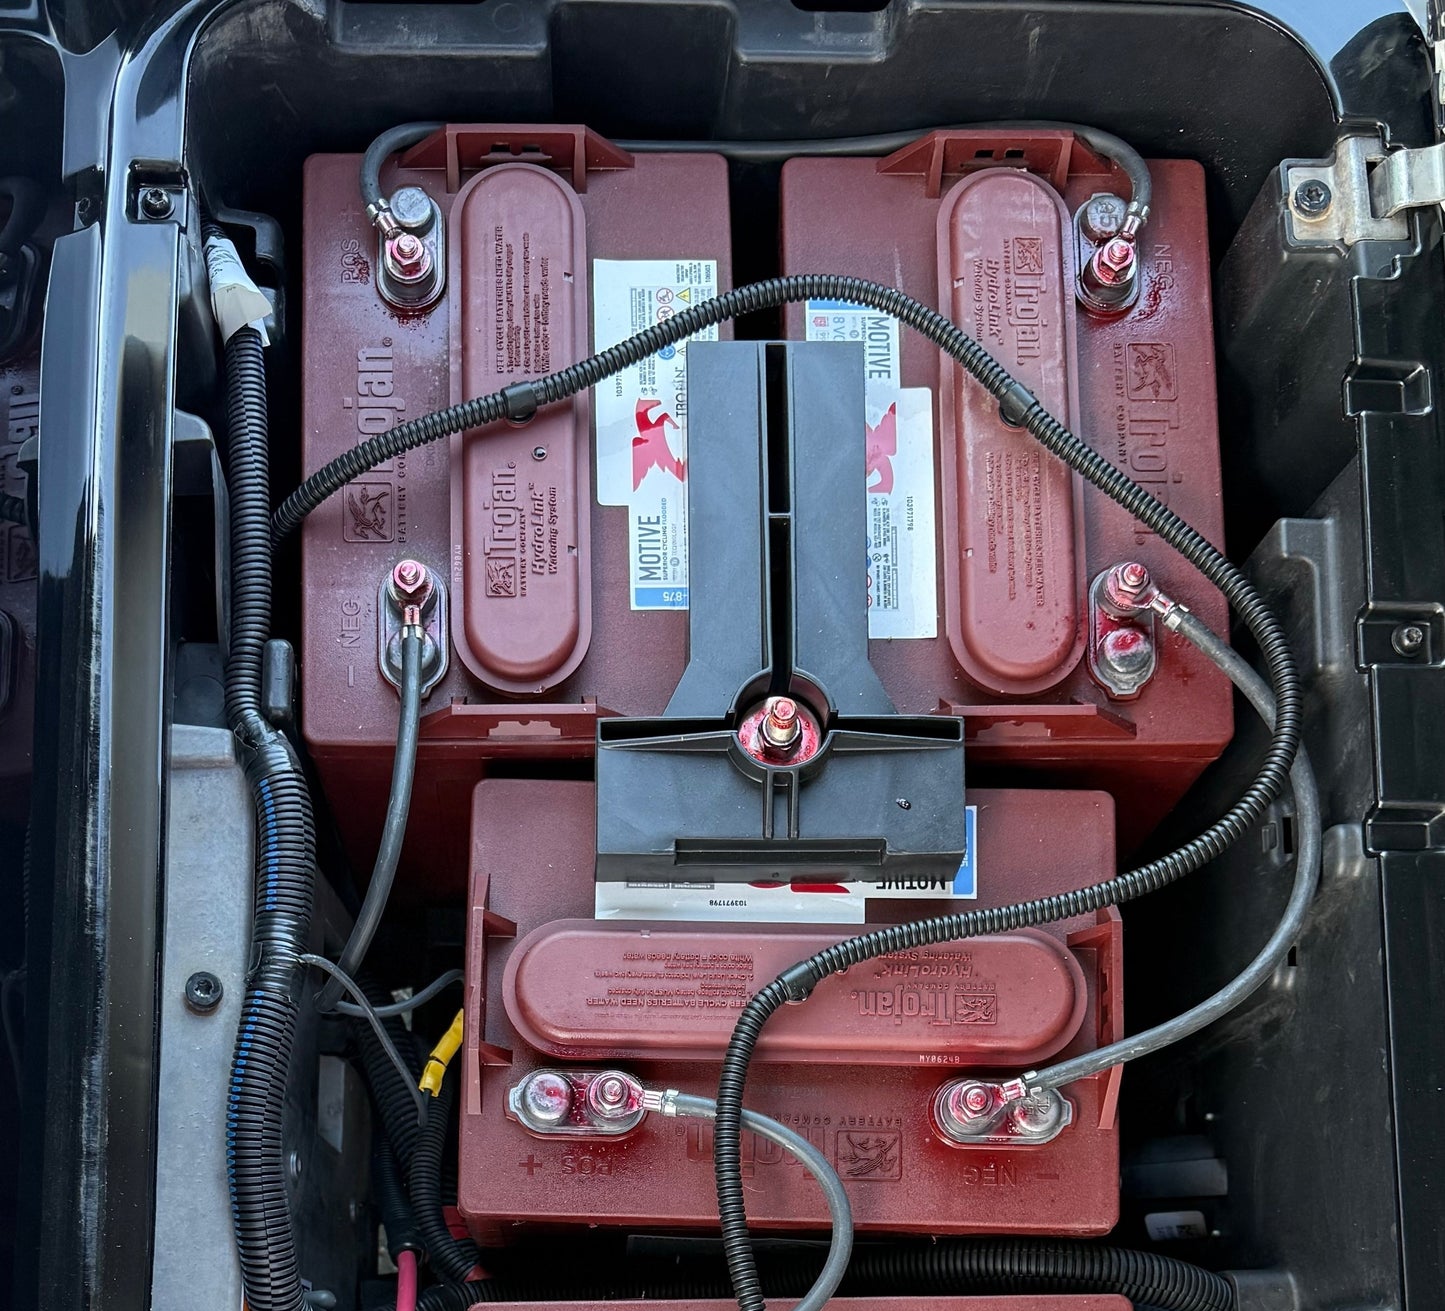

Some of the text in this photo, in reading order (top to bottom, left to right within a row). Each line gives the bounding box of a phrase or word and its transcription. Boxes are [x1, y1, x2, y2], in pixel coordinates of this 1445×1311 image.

[341, 239, 360, 283] POS
[1154, 244, 1174, 291] NEG
[973, 258, 984, 341] Watering System
[868, 317, 891, 379] MOTIVE
[1113, 343, 1127, 465] BATTERY COMPANY
[549, 487, 558, 574] Watering System
[906, 496, 914, 531] 103971798
[638, 516, 661, 580] MOTIVE
[341, 600, 361, 648] NEG
[709, 899, 747, 907] 103971798
[922, 951, 972, 961] Watering
[586, 998, 617, 1006] WATER
[621, 998, 644, 1006] NEED
[647, 998, 696, 1006] BATTERIES
[698, 999, 726, 1007] CYCLE
[561, 1155, 613, 1176] POS
[963, 1165, 1017, 1187] NEG
